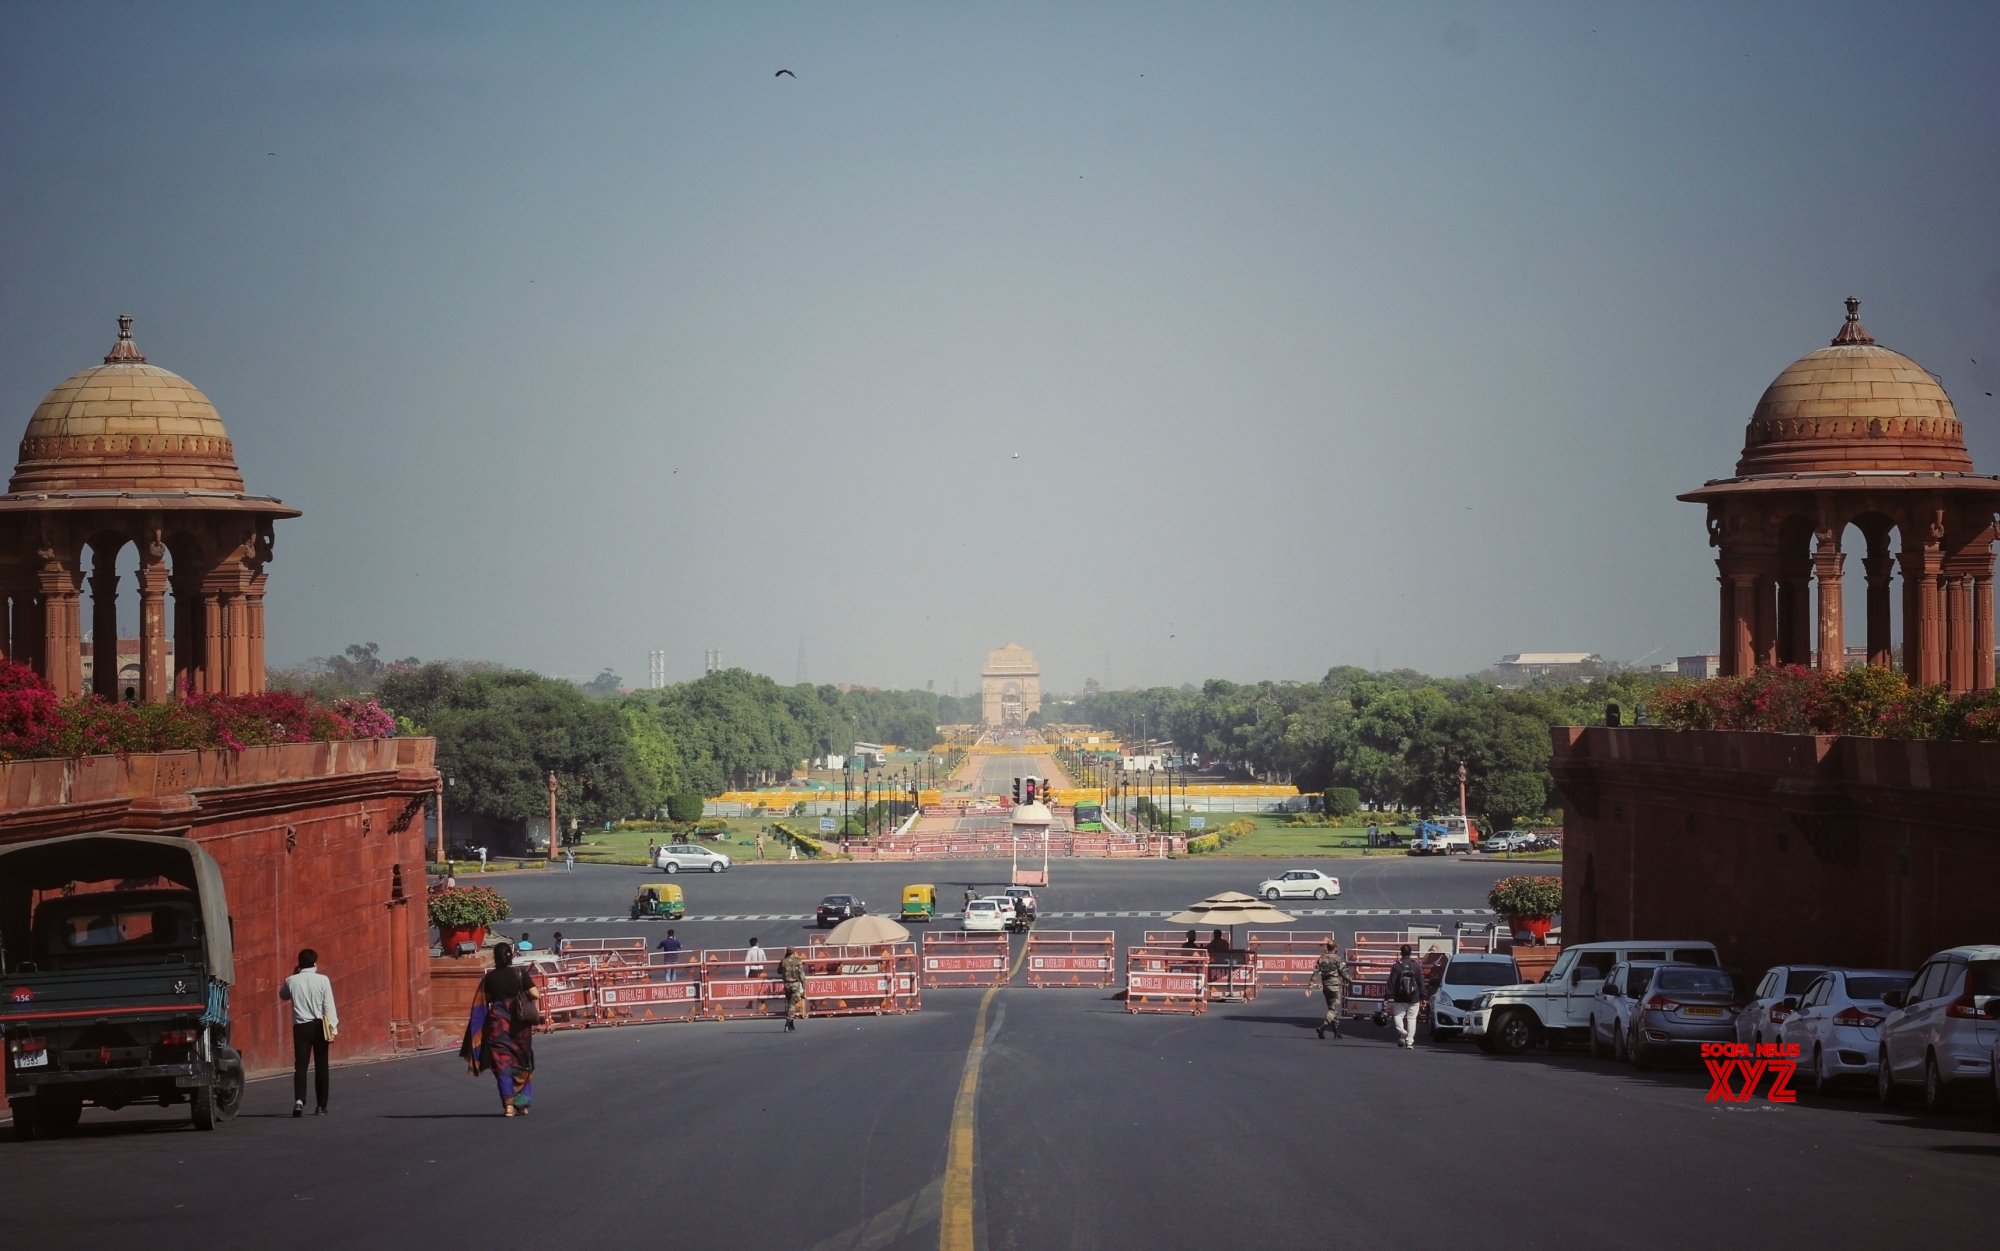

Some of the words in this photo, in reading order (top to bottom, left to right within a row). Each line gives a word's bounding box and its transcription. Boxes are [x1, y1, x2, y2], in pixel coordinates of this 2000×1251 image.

[726, 983, 754, 997] DELHI
[808, 981, 837, 993] DELHI
[841, 979, 875, 993] POLICE
[1166, 978, 1194, 991] POLICE
[15, 994, 30, 1002] 256
[547, 993, 576, 1008] OLICE
[619, 988, 647, 1001] DELHI
[651, 986, 684, 999] POLICE
